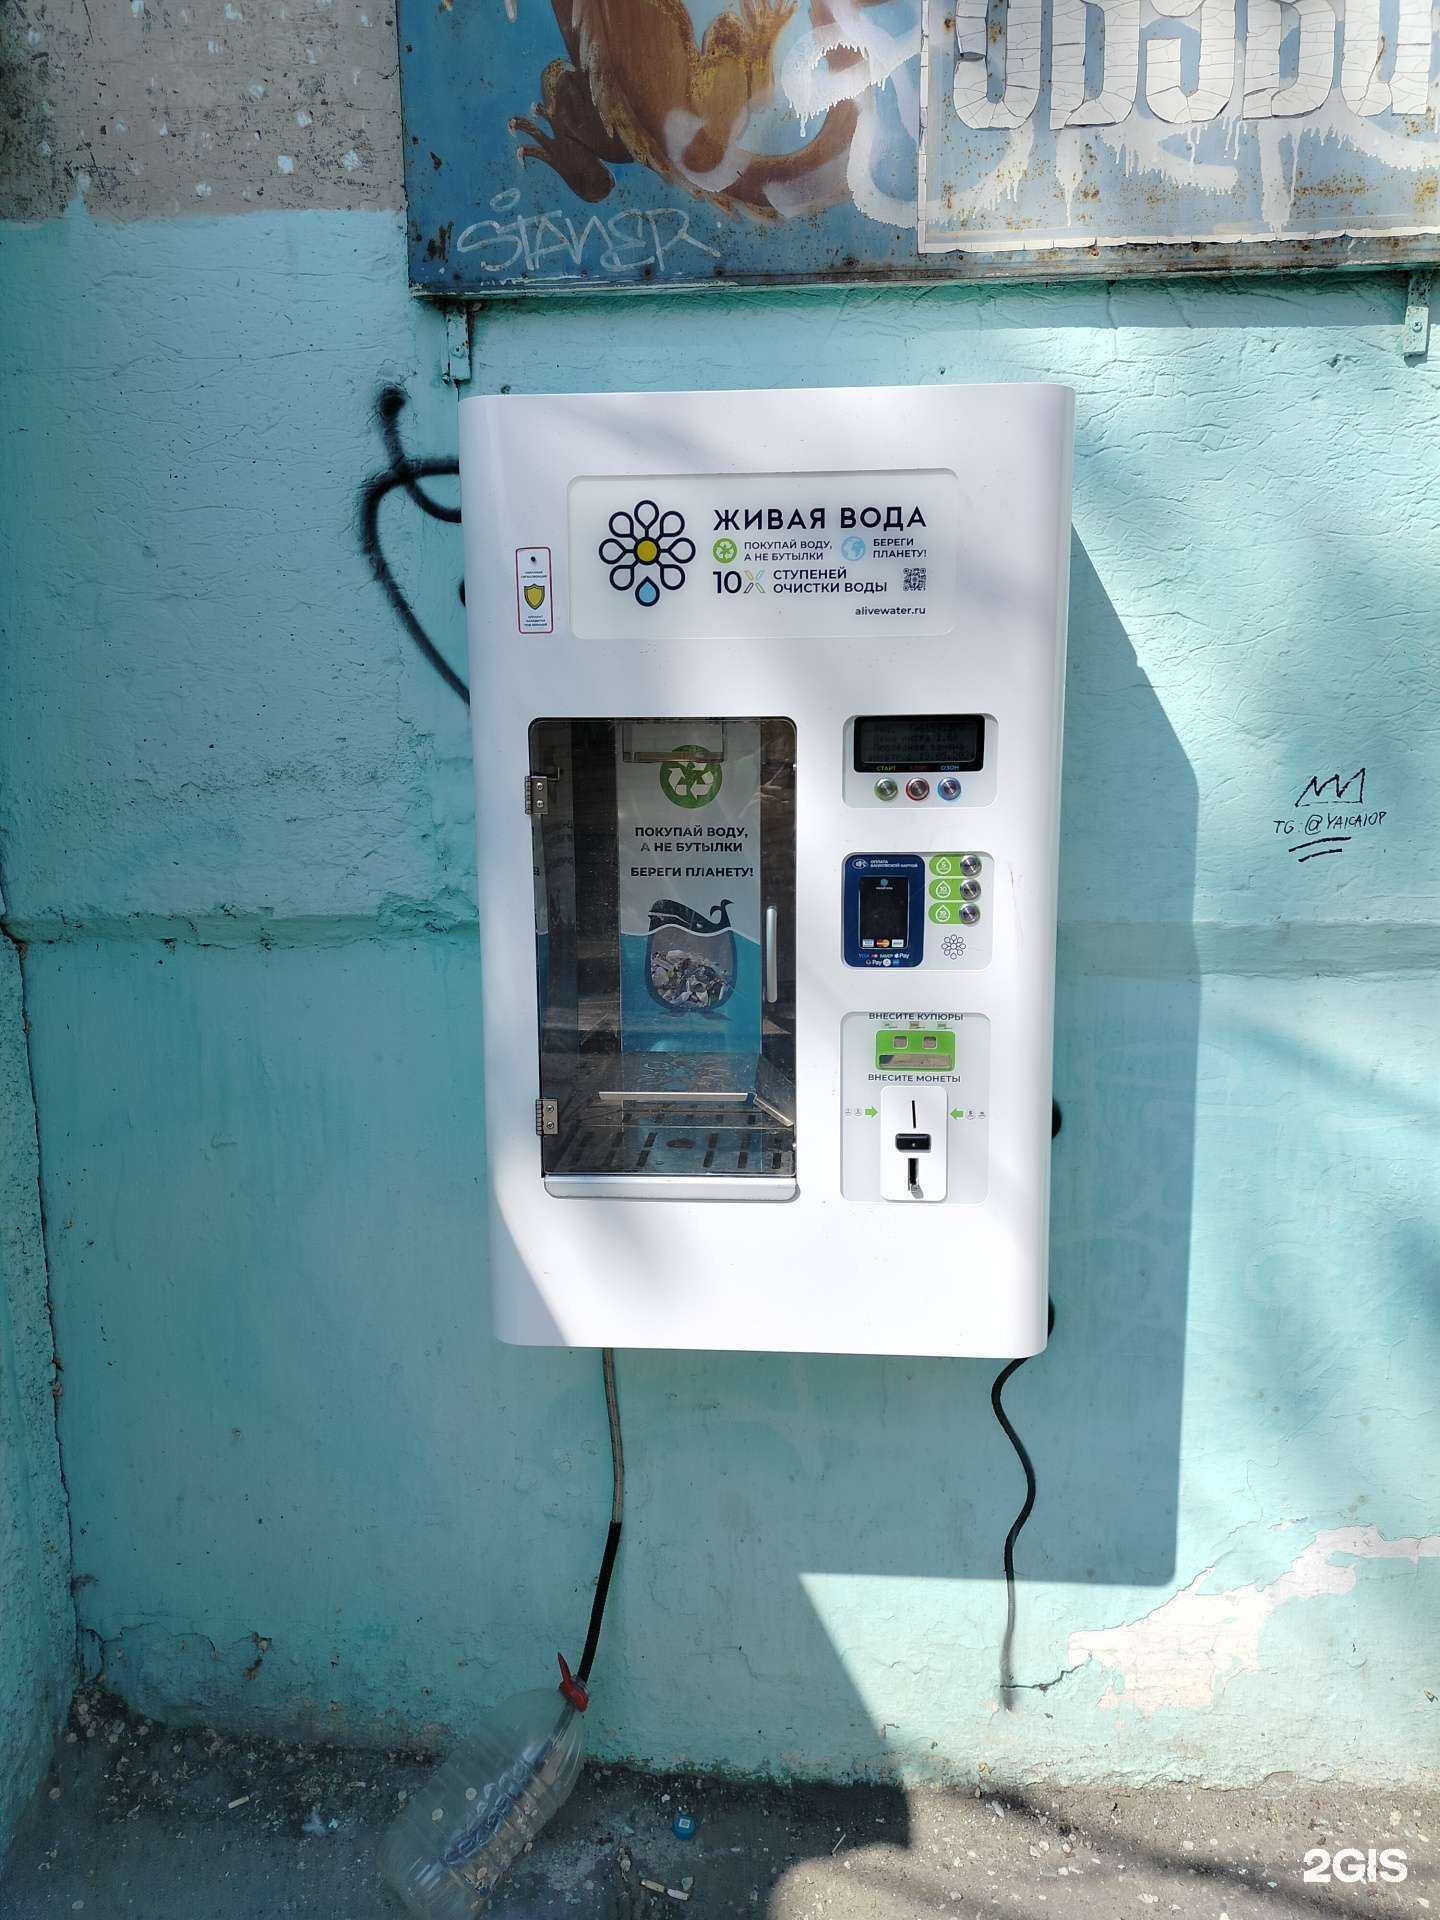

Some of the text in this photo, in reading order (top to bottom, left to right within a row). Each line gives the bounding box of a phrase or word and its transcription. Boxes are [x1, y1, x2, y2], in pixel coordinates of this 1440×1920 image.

[713, 505, 927, 531] ЖИВАЯ ВОДА
[744, 539, 832, 550] ПОКУПАЙ ВОДУ,
[873, 538, 914, 547] БЕРЕГИ
[744, 552, 824, 561] А НЕ БУТЫЛКИ
[873, 549, 927, 559] ПЛАНЕТУ!
[773, 567, 847, 580] СТУПЕНЕЙ
[773, 582, 887, 594] ОЧИСТКИ ВОДЫ
[855, 606, 926, 616] alivewater.ru
[635, 825, 747, 839] ПОКУПАЙ ВОДУ,
[640, 841, 743, 853] А НЕ БУТЫЛКИ
[630, 867, 754, 877] БЕРЕГИ ПЛАНЕТУ!
[869, 1012, 964, 1021] ВНЕСИТЕ КУПЮРЫ
[868, 1073, 961, 1083] ВНЕСИТЕ МОНЕТЫ
